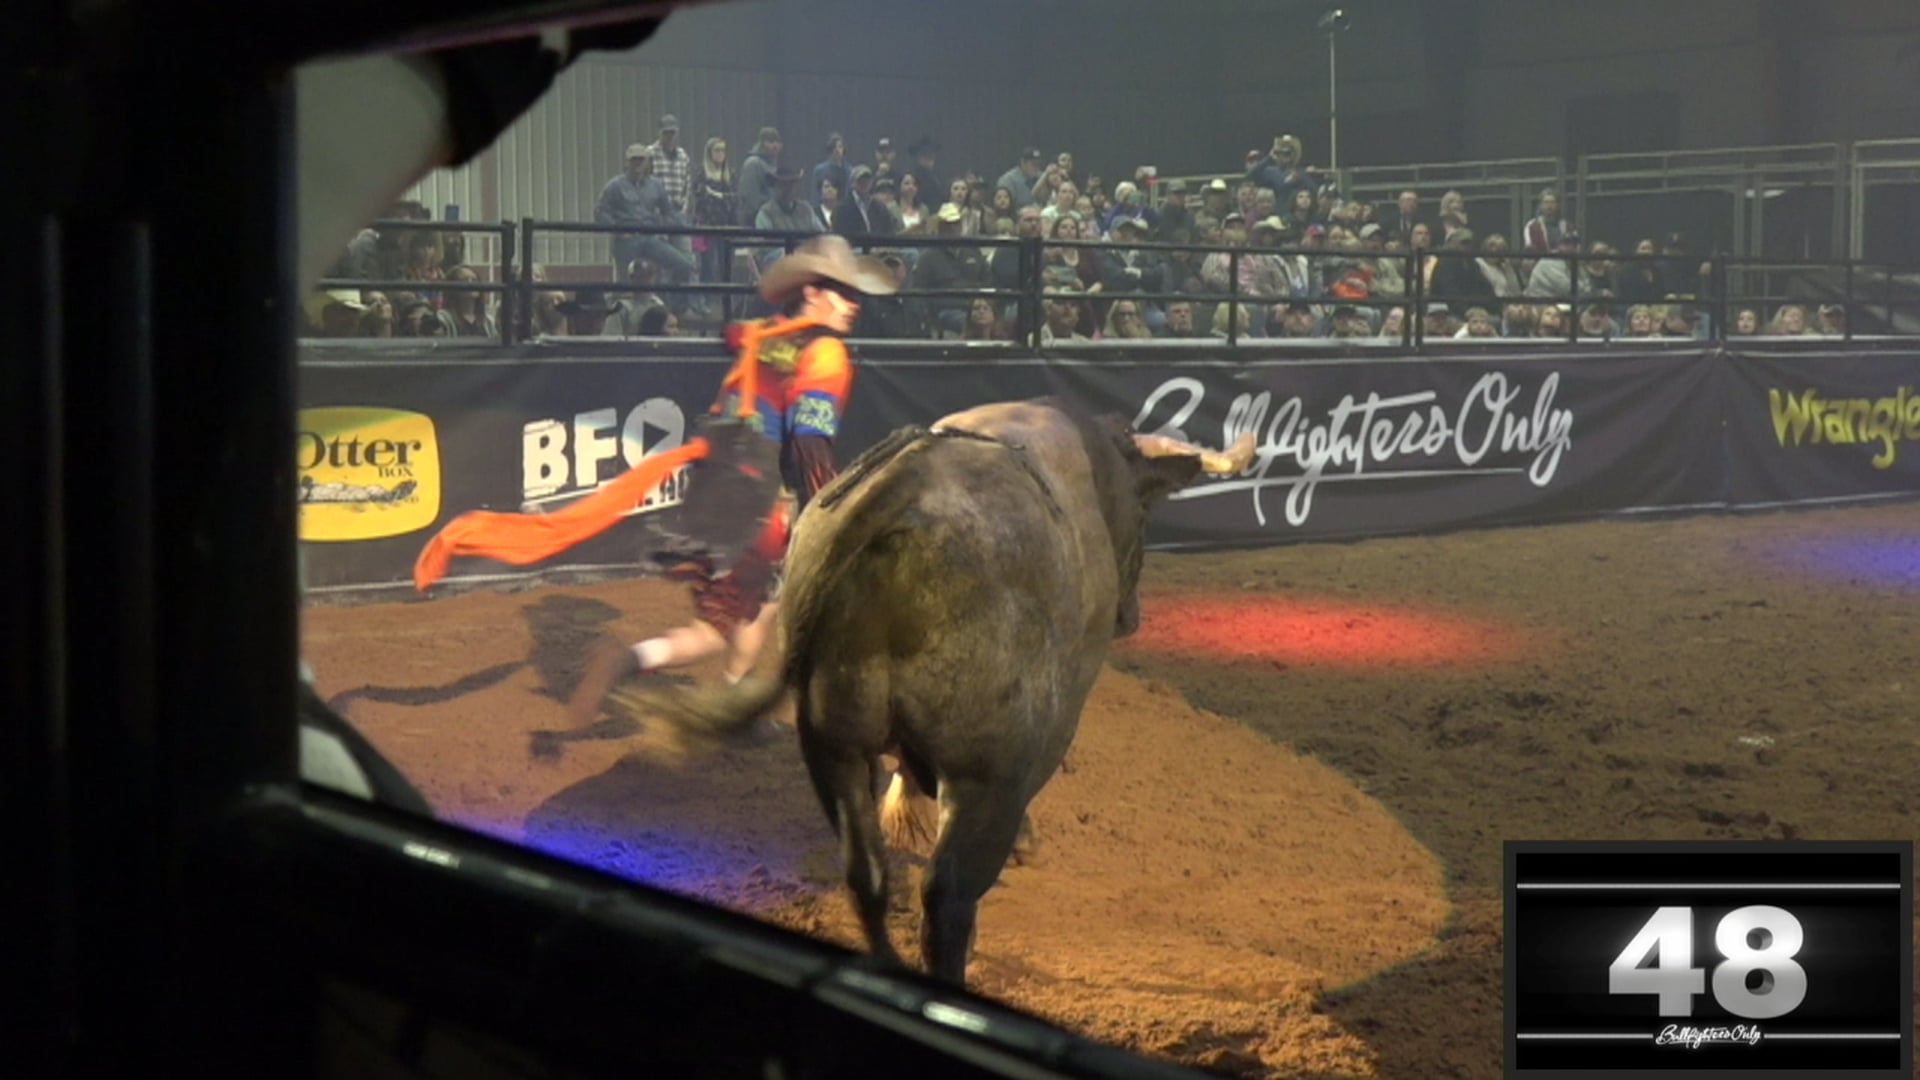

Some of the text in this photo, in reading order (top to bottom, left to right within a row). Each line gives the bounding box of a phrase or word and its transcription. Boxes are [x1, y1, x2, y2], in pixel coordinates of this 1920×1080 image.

[1132, 371, 1574, 525] Bllfighters Only
[1768, 386, 1920, 469] Wrangle
[377, 467, 414, 478] BOX
